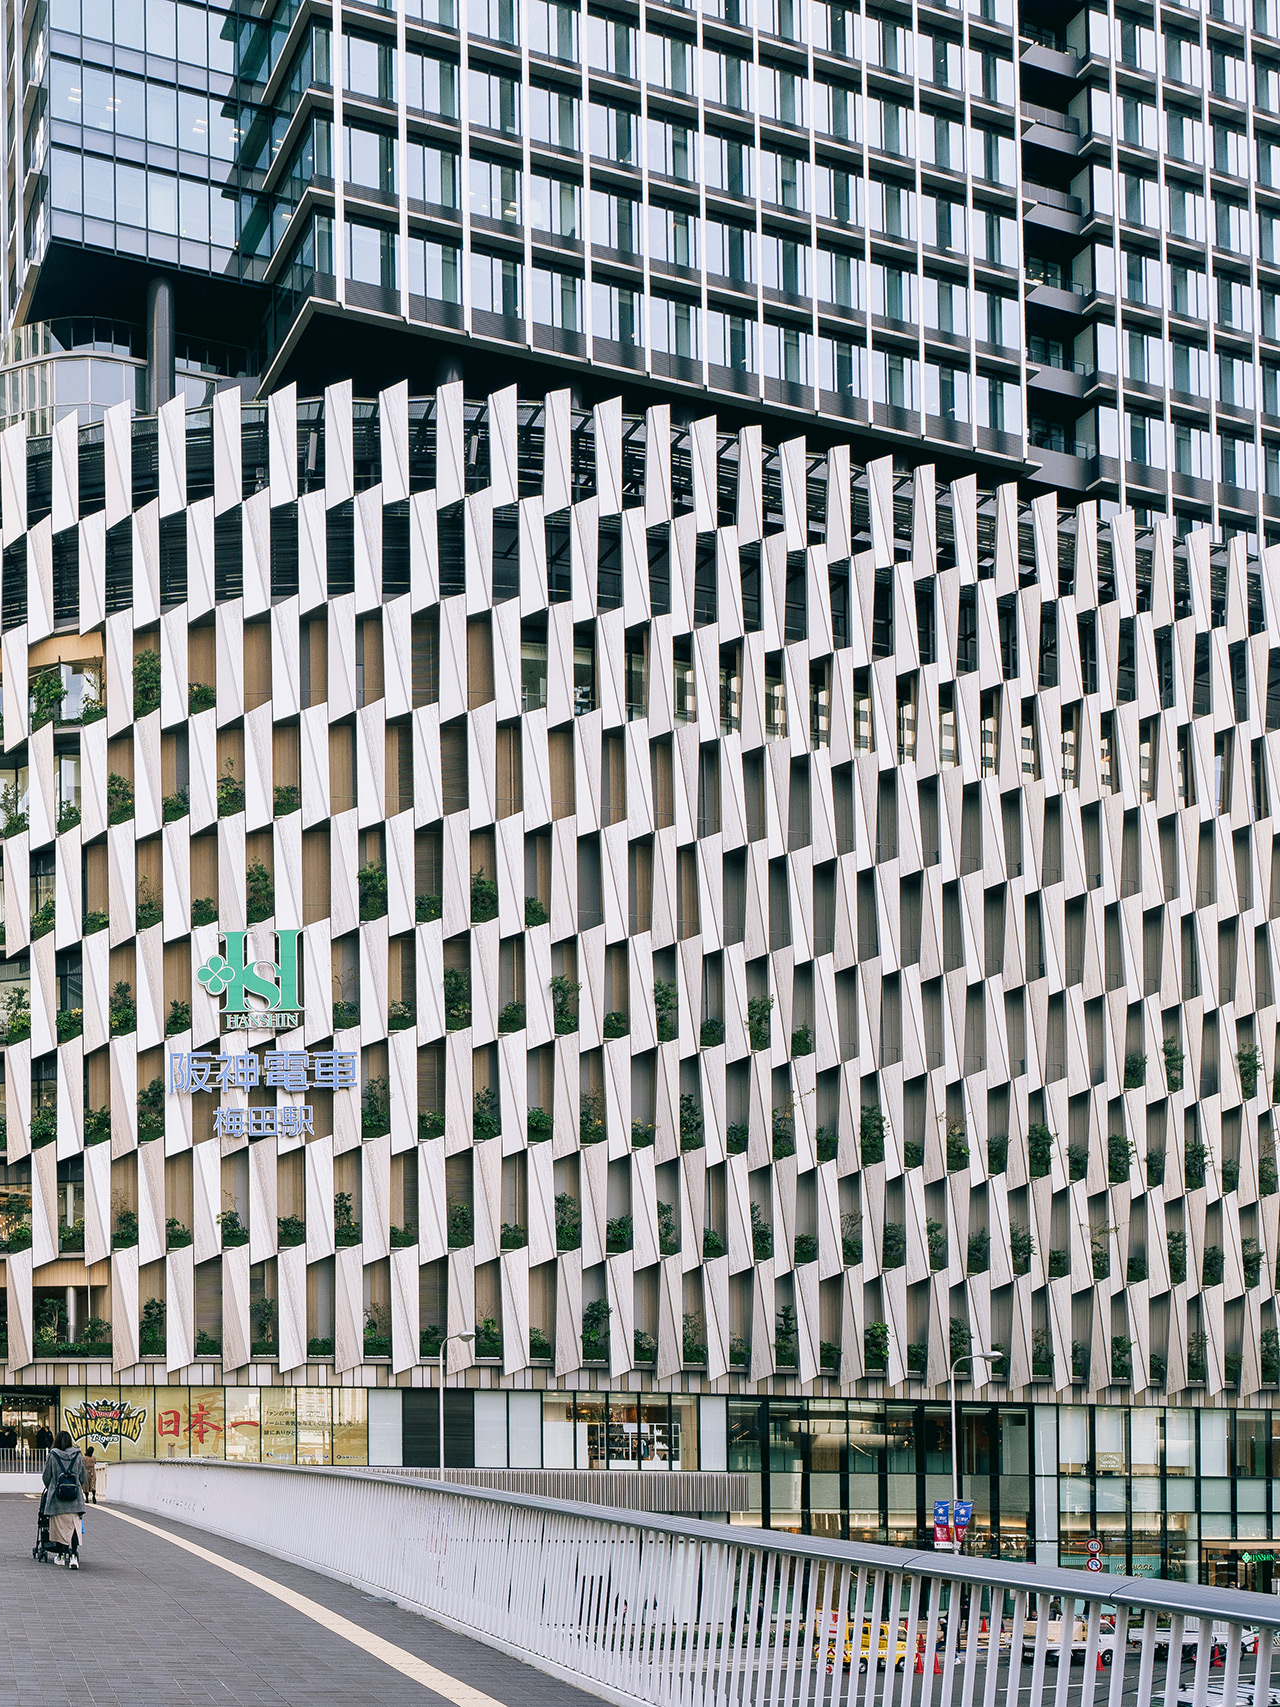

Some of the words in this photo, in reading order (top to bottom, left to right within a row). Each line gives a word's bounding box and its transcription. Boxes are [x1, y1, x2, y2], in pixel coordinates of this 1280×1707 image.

[226, 1012, 299, 1028] HANSHIN
[169, 1049, 358, 1094] 阪神電車
[213, 1105, 315, 1137] 梅田駅
[158, 1403, 260, 1445] 日本一
[91, 1433, 119, 1443] Tigers
[1089, 1542, 1099, 1551] 40
